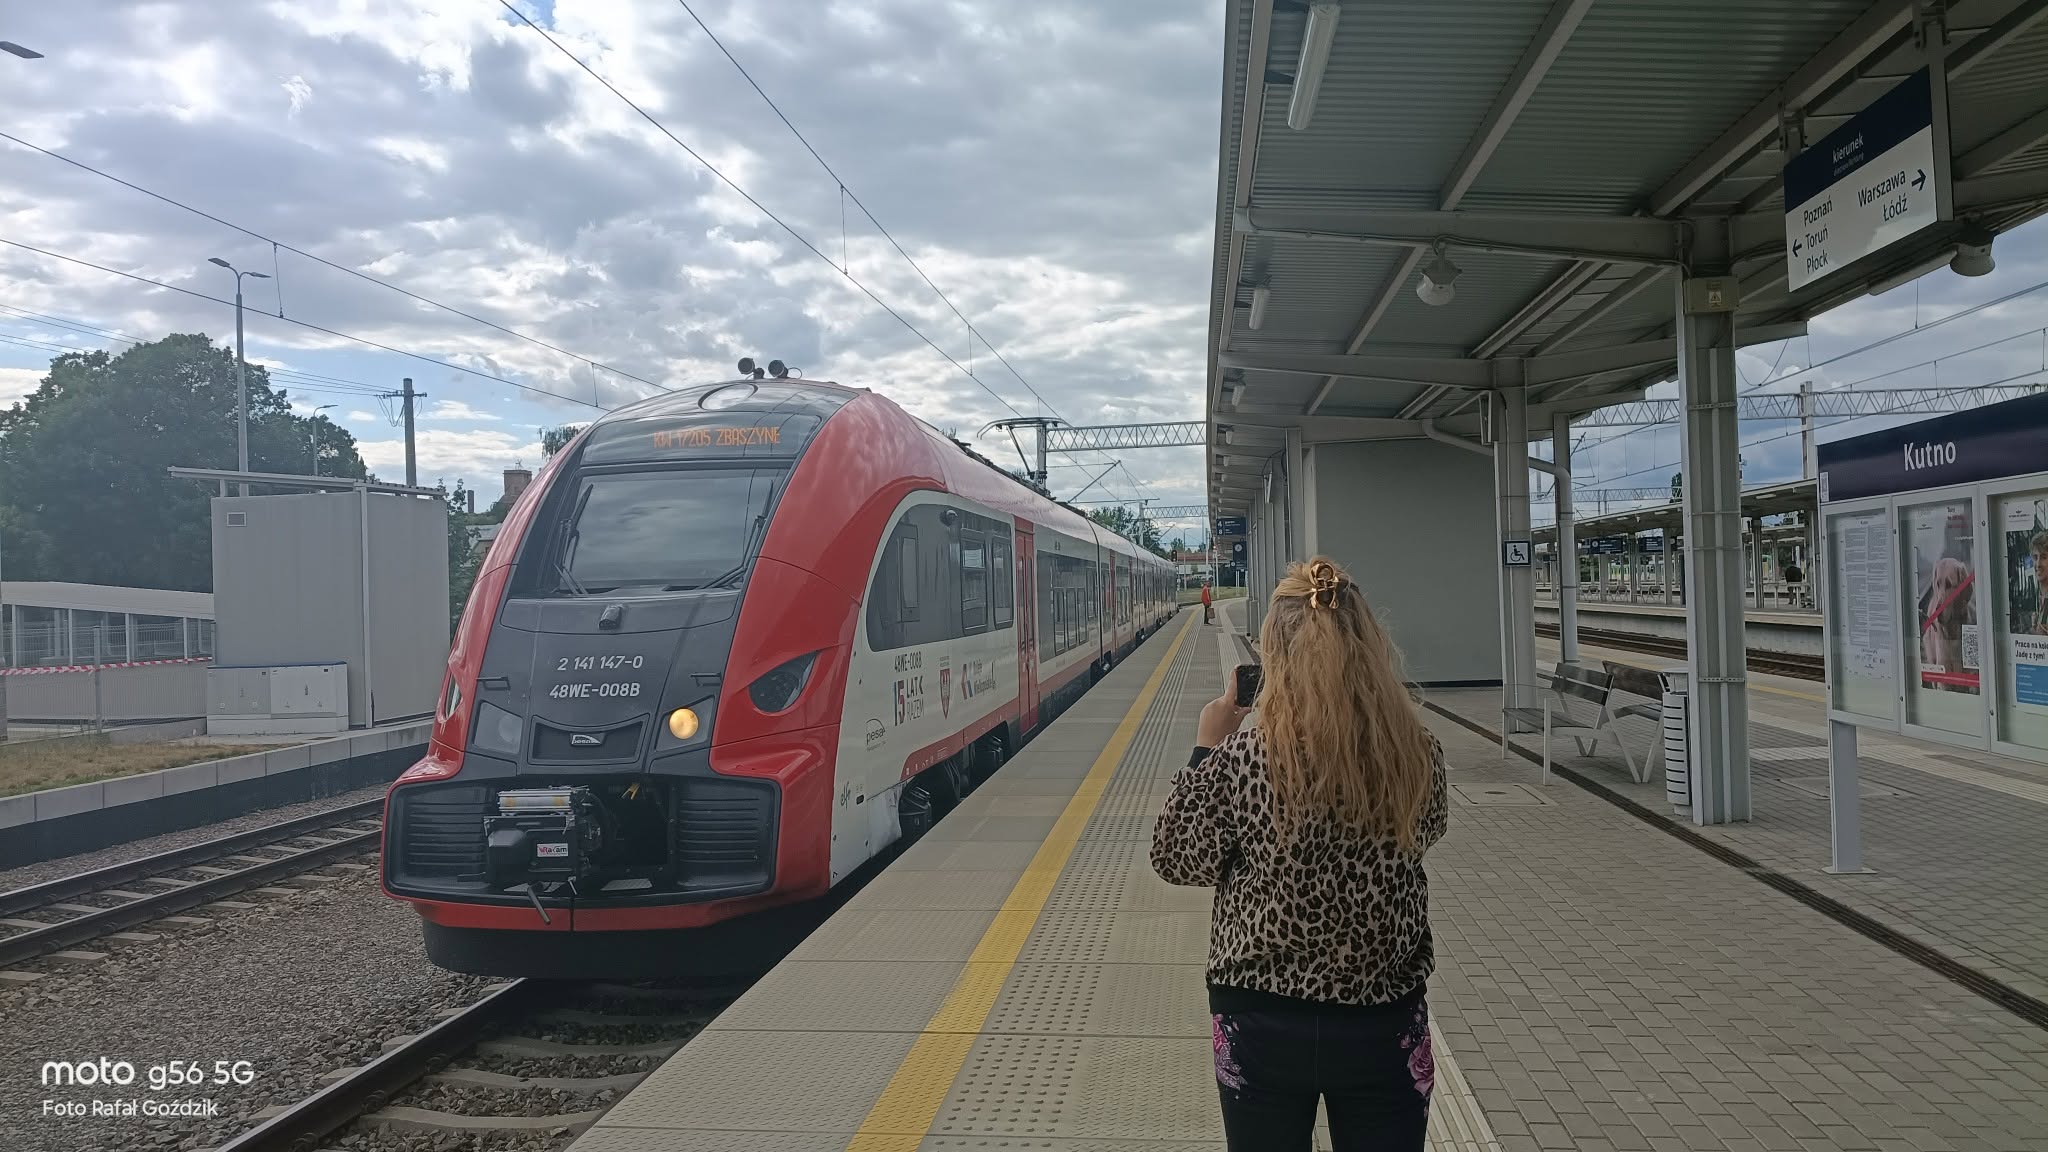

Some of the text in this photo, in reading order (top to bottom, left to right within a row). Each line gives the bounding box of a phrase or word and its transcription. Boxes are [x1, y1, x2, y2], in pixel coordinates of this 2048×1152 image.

[1832, 132, 1864, 164] kierunek
[1857, 168, 1906, 208] Warszawa
[1803, 195, 1833, 227] Poznań
[1883, 193, 1908, 222] Łódź
[1805, 222, 1828, 251] Toruń
[1806, 250, 1829, 275] Płock
[1903, 441, 1957, 472] Kutno
[2016, 640, 2030, 648] Praca
[557, 655, 644, 671] 2 141 147-0
[549, 682, 641, 699] 48WE-008B
[866, 728, 885, 745] pesa
